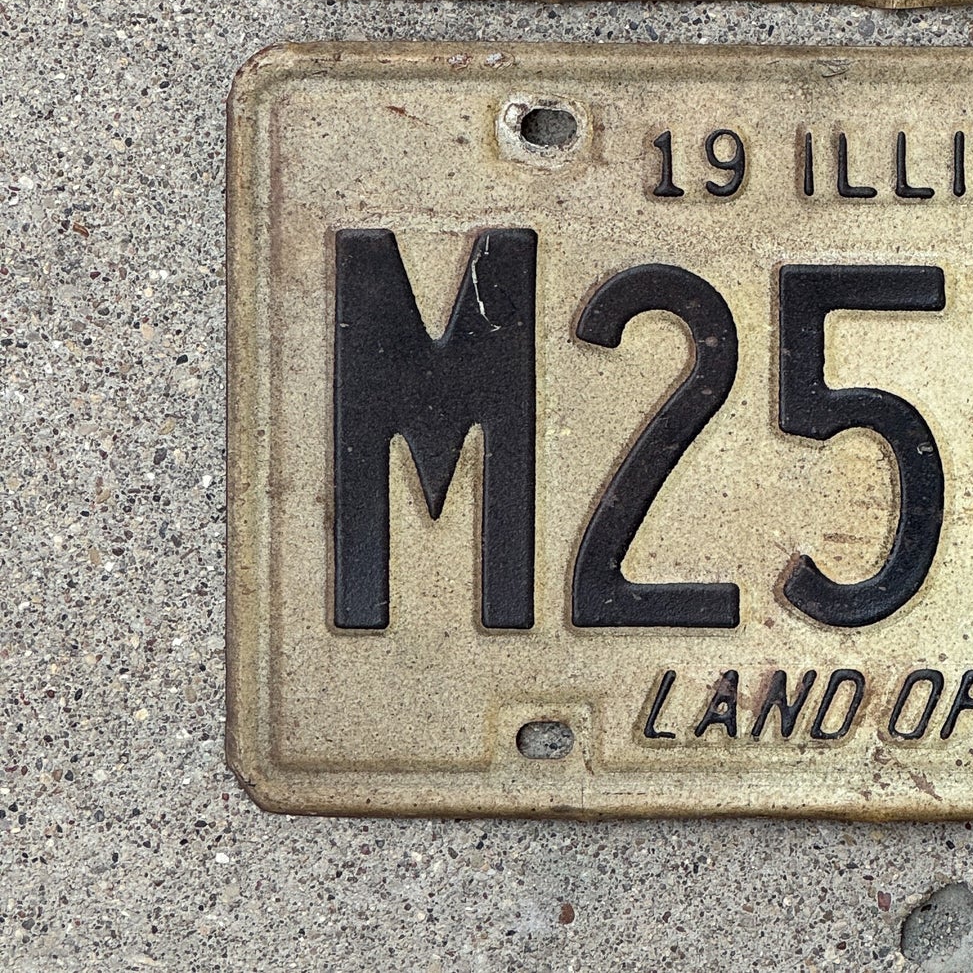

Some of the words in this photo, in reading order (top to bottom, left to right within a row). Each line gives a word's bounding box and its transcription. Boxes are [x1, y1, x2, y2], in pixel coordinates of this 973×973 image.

[652, 128, 746, 198] 19
[333, 227, 947, 630] M25
[644, 668, 866, 741] LAND
